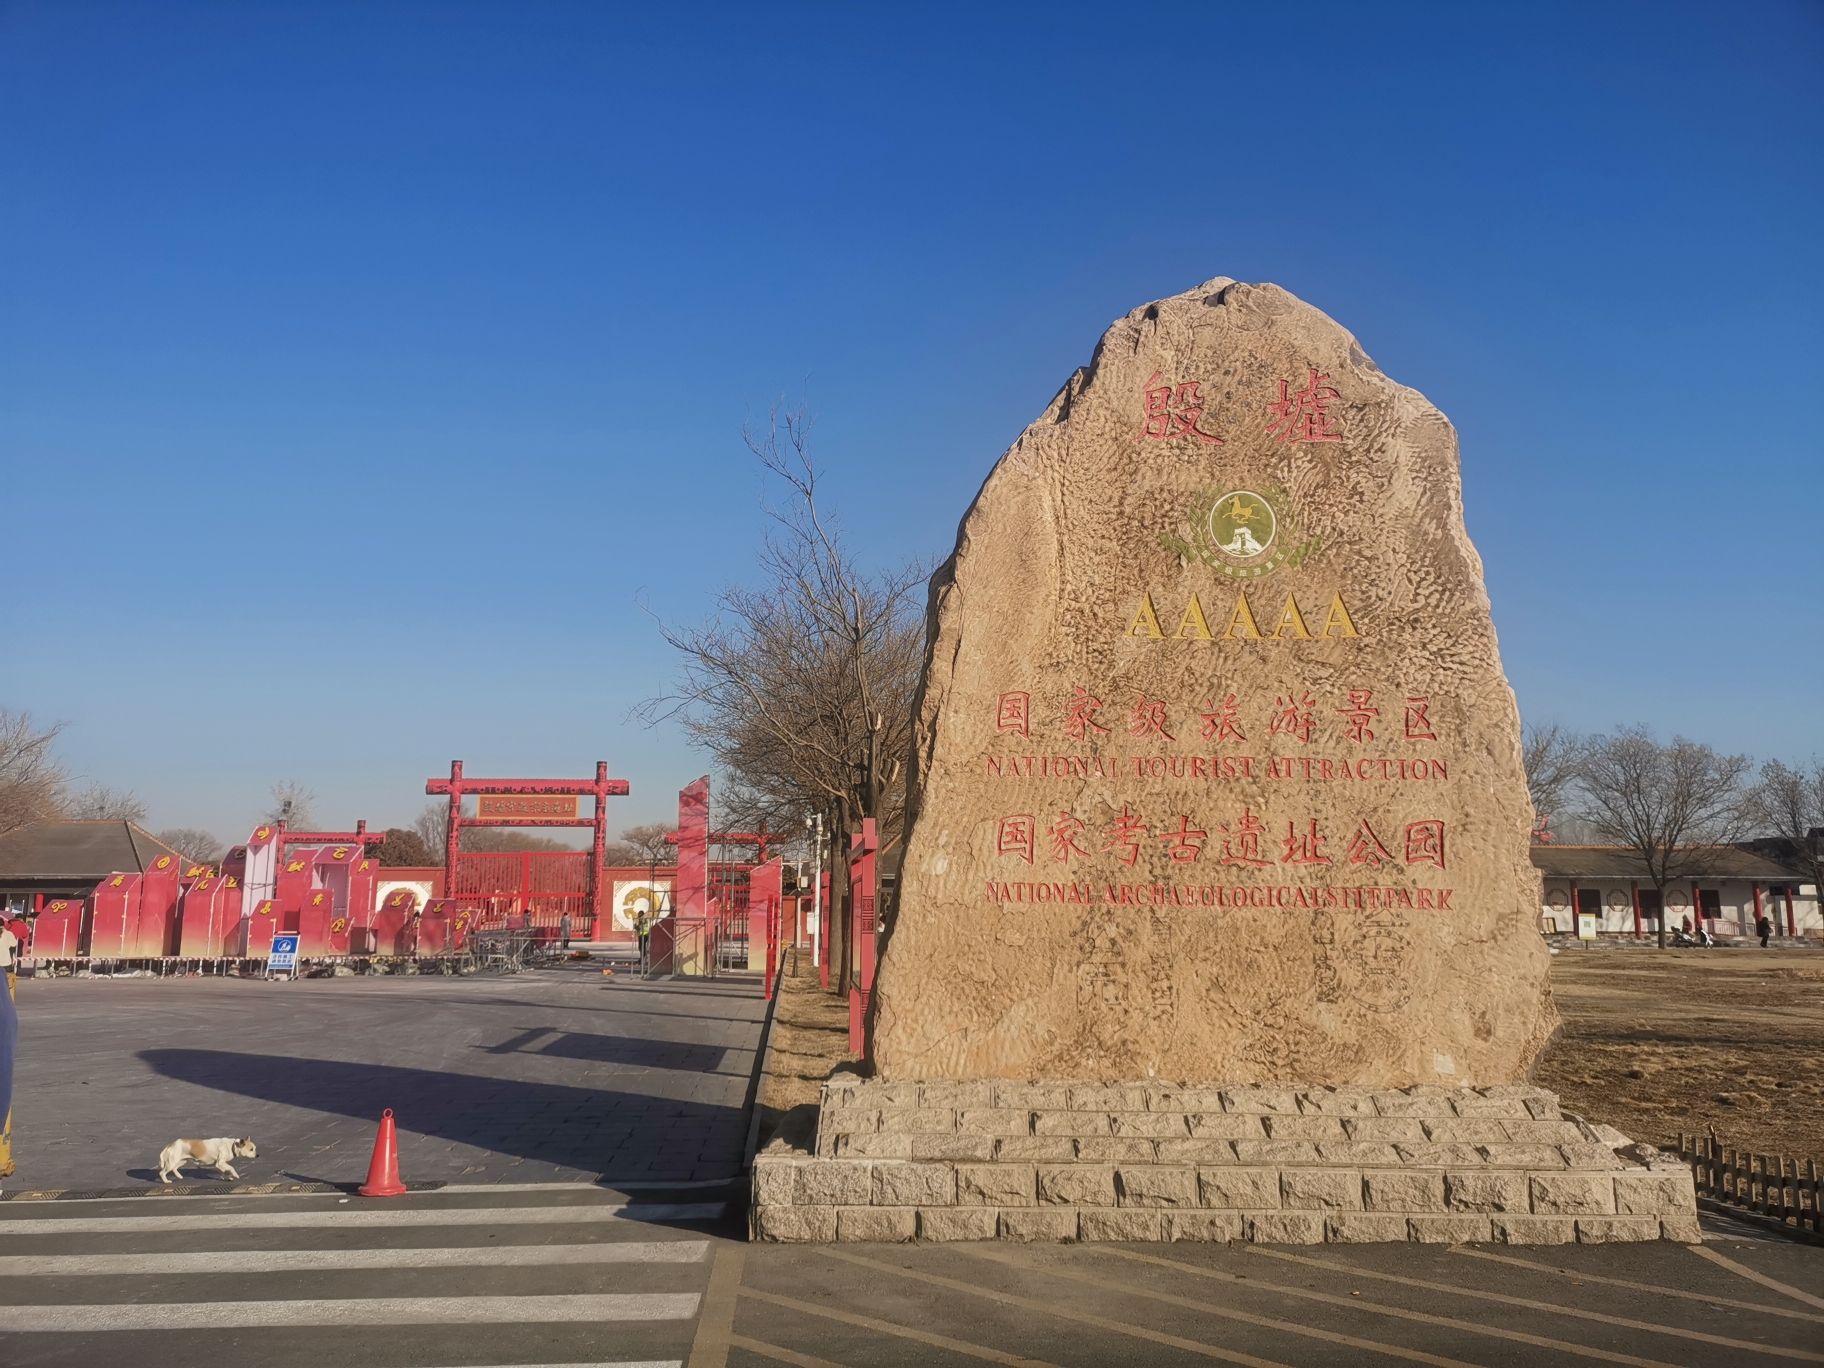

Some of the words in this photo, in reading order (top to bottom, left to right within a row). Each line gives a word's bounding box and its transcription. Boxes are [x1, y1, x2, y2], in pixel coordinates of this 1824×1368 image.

[1134, 368, 1344, 446] 殷墟
[996, 687, 1437, 743] 国家级旅游景区
[987, 756, 1122, 778] NATIONAL
[1131, 757, 1254, 779] TOURIST
[1267, 758, 1448, 780] ATTRACTION
[997, 804, 1446, 869] 国家考古遗址公园
[986, 881, 1097, 904] NATIONAL
